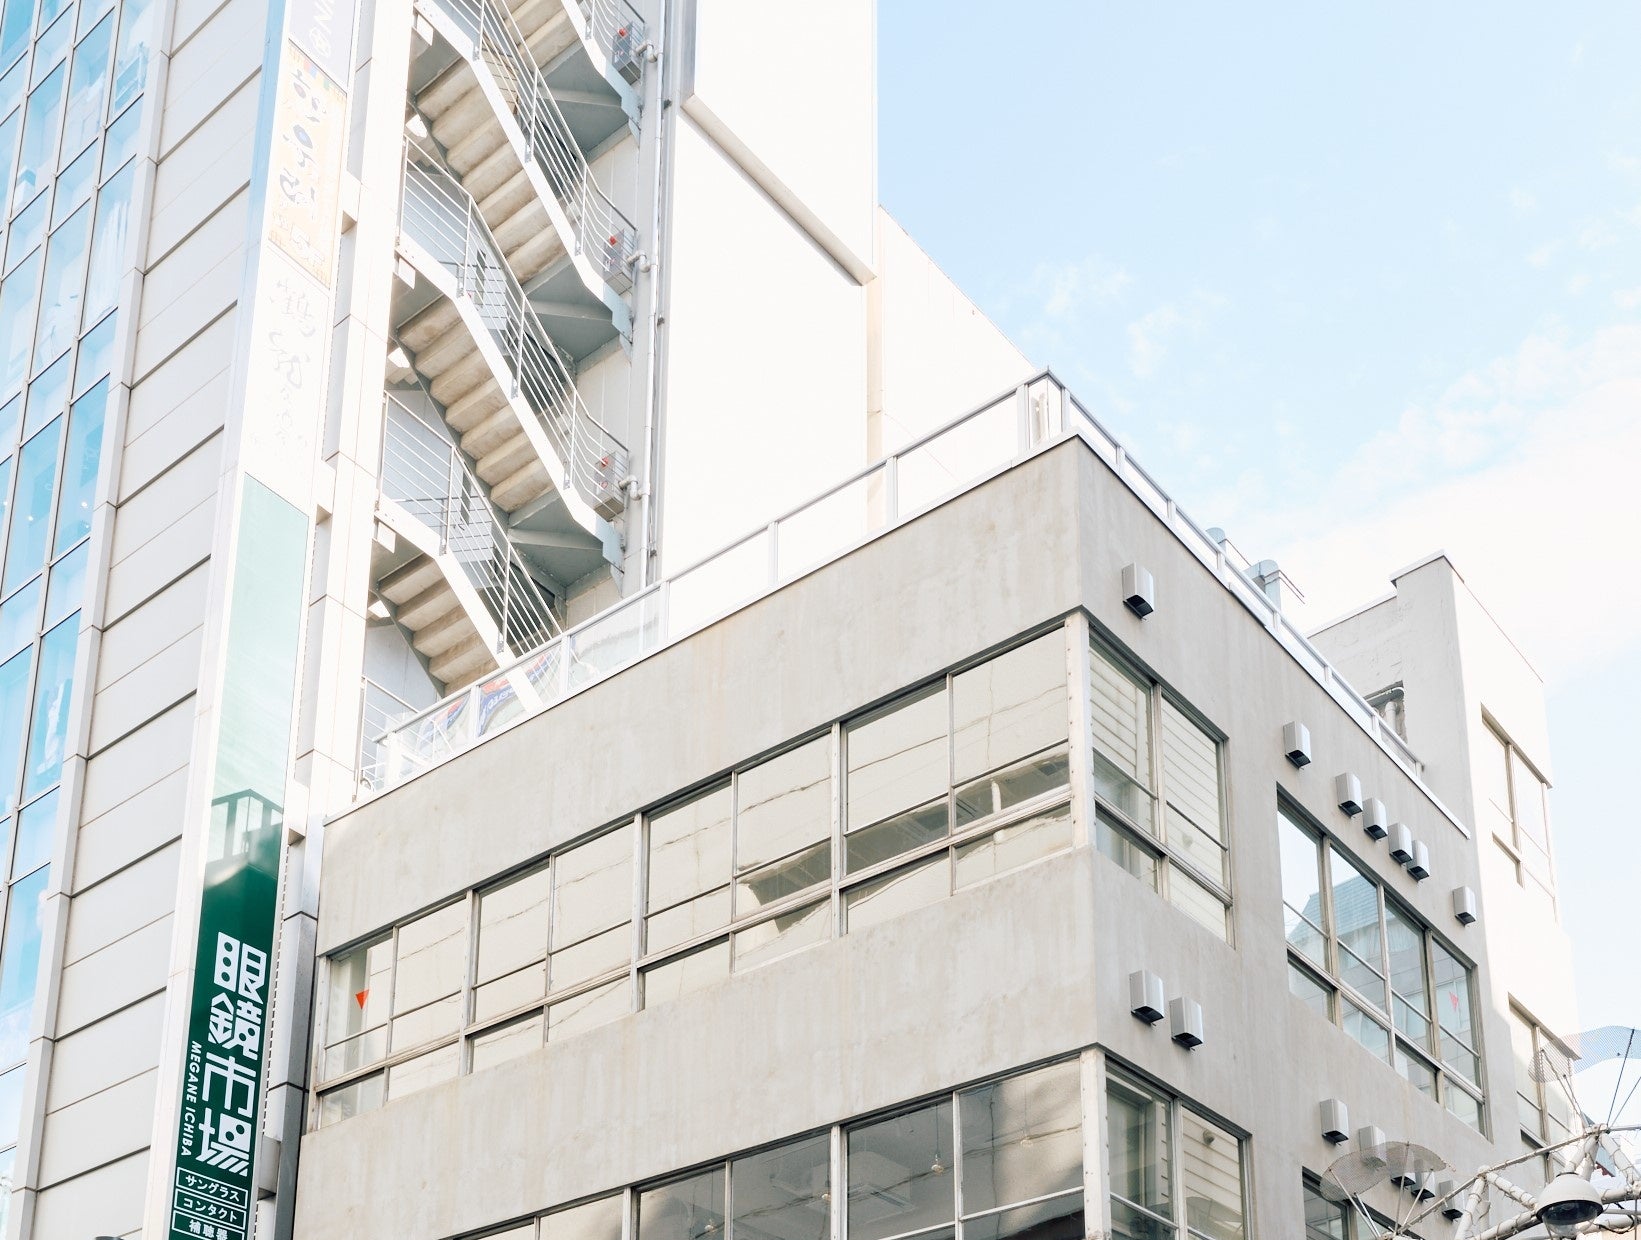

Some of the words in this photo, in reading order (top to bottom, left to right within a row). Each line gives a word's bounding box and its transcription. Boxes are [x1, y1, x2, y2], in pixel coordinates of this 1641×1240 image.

[186, 1040, 202, 1103] MEGANE
[196, 932, 267, 1176] 眼鏡市場
[180, 1108, 195, 1157] ICHIBA
[183, 1197, 237, 1222] コンタクト
[185, 1174, 239, 1202] サングラス
